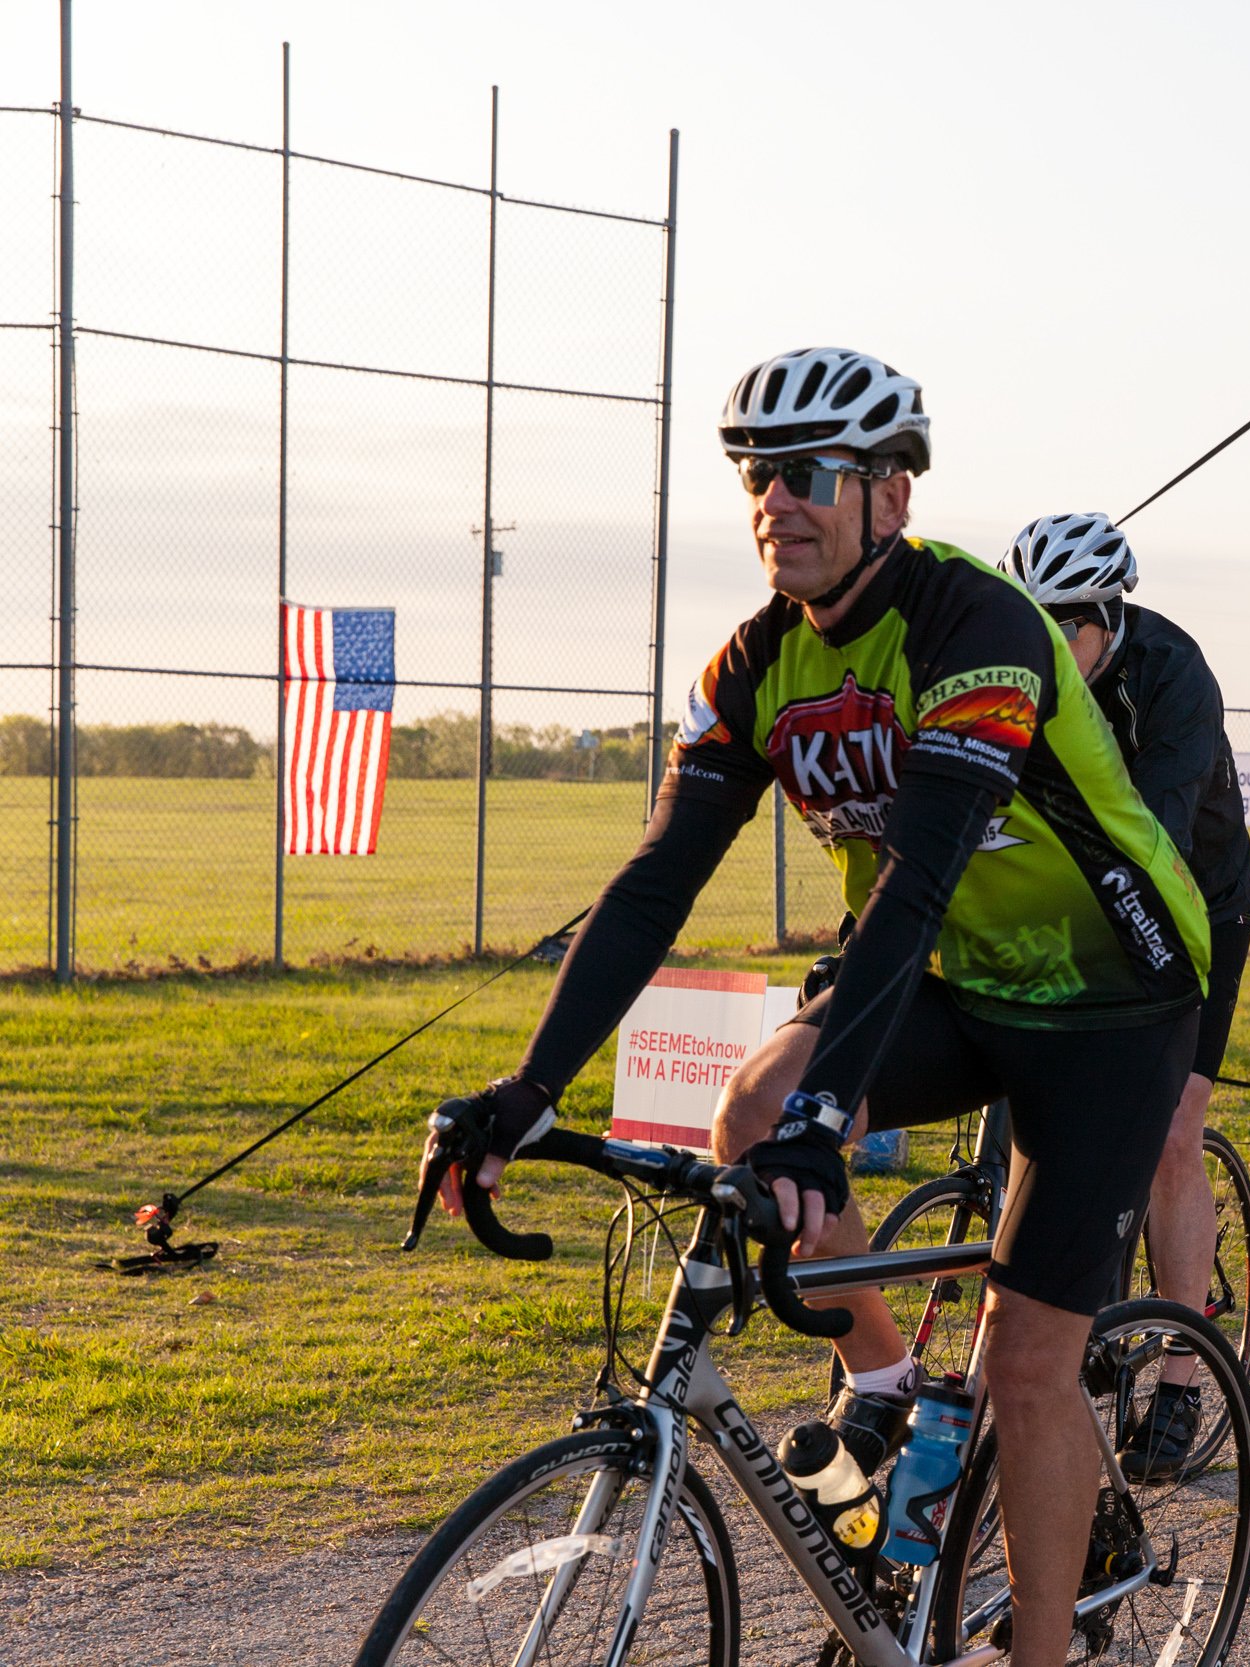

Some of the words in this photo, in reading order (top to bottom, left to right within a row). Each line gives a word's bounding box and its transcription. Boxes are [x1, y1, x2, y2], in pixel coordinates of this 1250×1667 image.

[916, 670, 1040, 711] CHAMPION
[791, 722, 899, 796] KATY
[963, 737, 1011, 763] Missouri
[1121, 890, 1174, 966] trailnet
[626, 1055, 651, 1080] I'M
[654, 1058, 666, 1081] A
[670, 1060, 738, 1087] FIGHTE
[628, 1029, 747, 1060] #SEEMEtoknow
[649, 1343, 698, 1567] cannondale
[713, 1398, 881, 1634] cannondale
